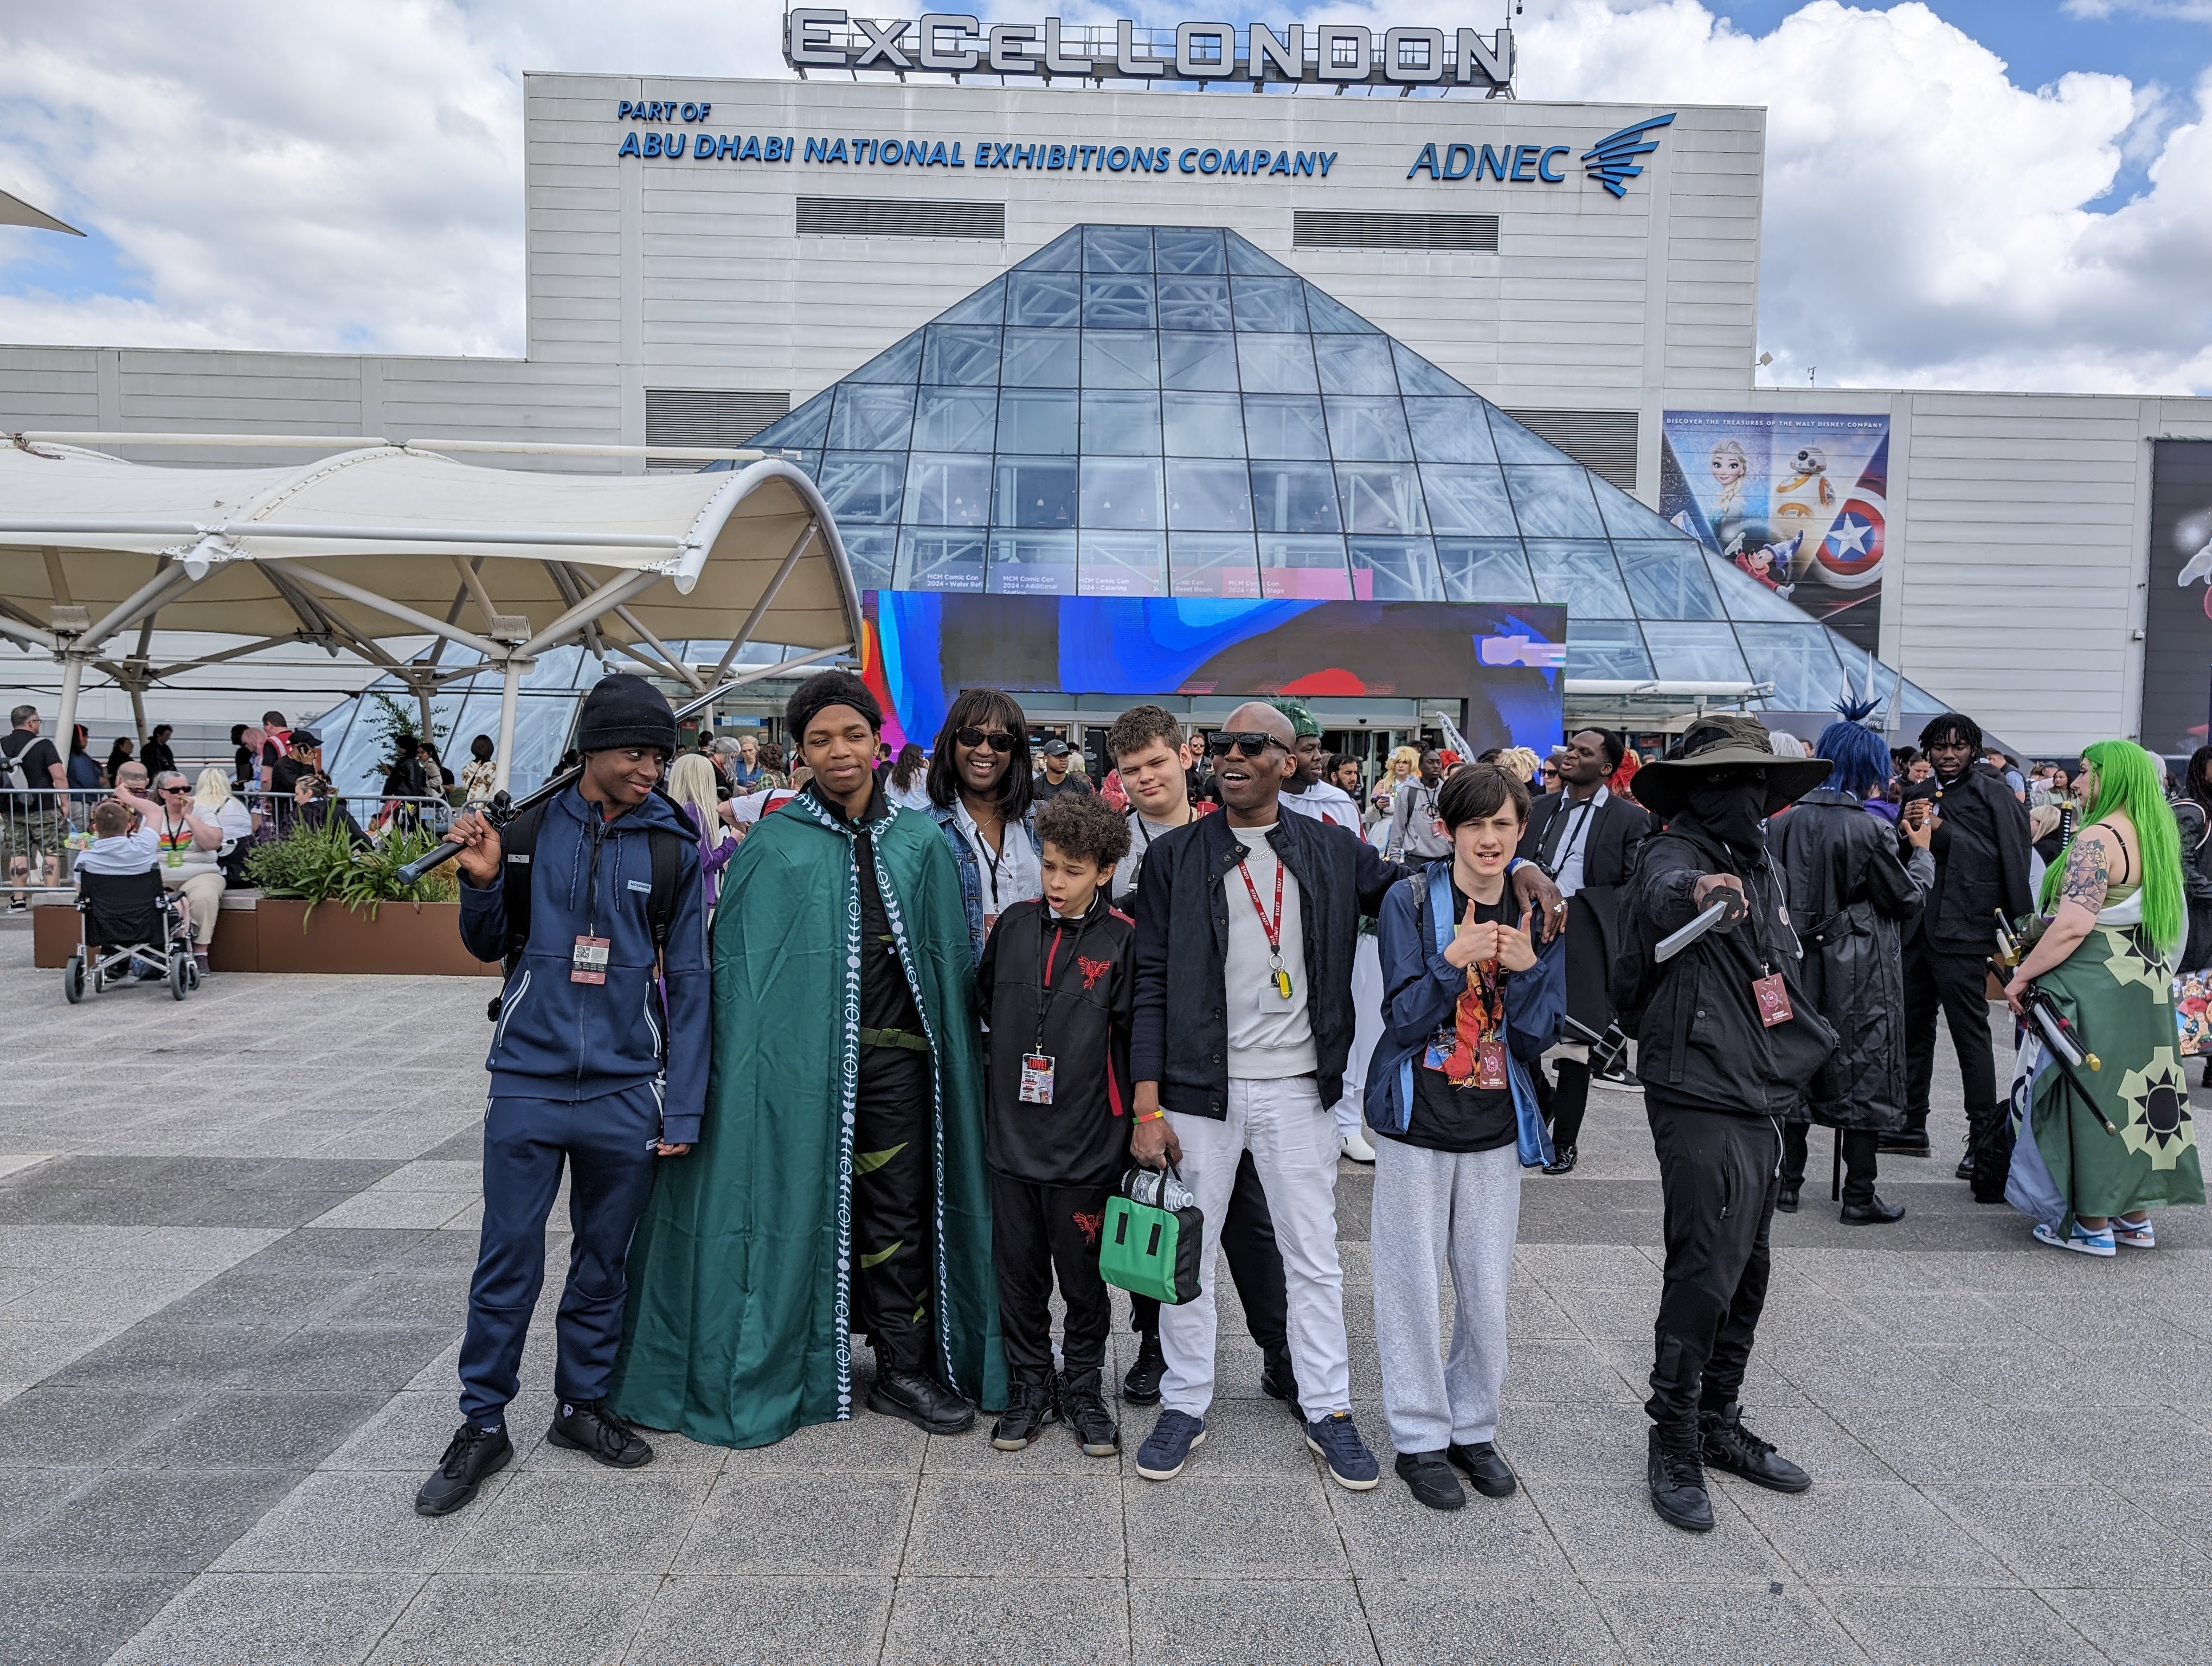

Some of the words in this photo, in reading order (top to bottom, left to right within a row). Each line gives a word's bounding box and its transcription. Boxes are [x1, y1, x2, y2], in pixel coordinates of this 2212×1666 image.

[1117, 20, 1512, 85] LONDON
[618, 100, 677, 120] PART
[680, 102, 711, 122] OF
[618, 132, 686, 159] ABU
[693, 134, 794, 162] DHABI
[803, 136, 965, 167] NATIONAL
[975, 142, 1171, 172] EXHIBITIONS
[1179, 148, 1339, 177] COMPANY
[1406, 142, 1571, 183] ADNEC
[1240, 866, 1250, 880] STAFF
[1250, 889, 1259, 904] STAFF
[1259, 912, 1270, 926] STAFF
[1029, 1059, 1047, 1069] LOVE!
